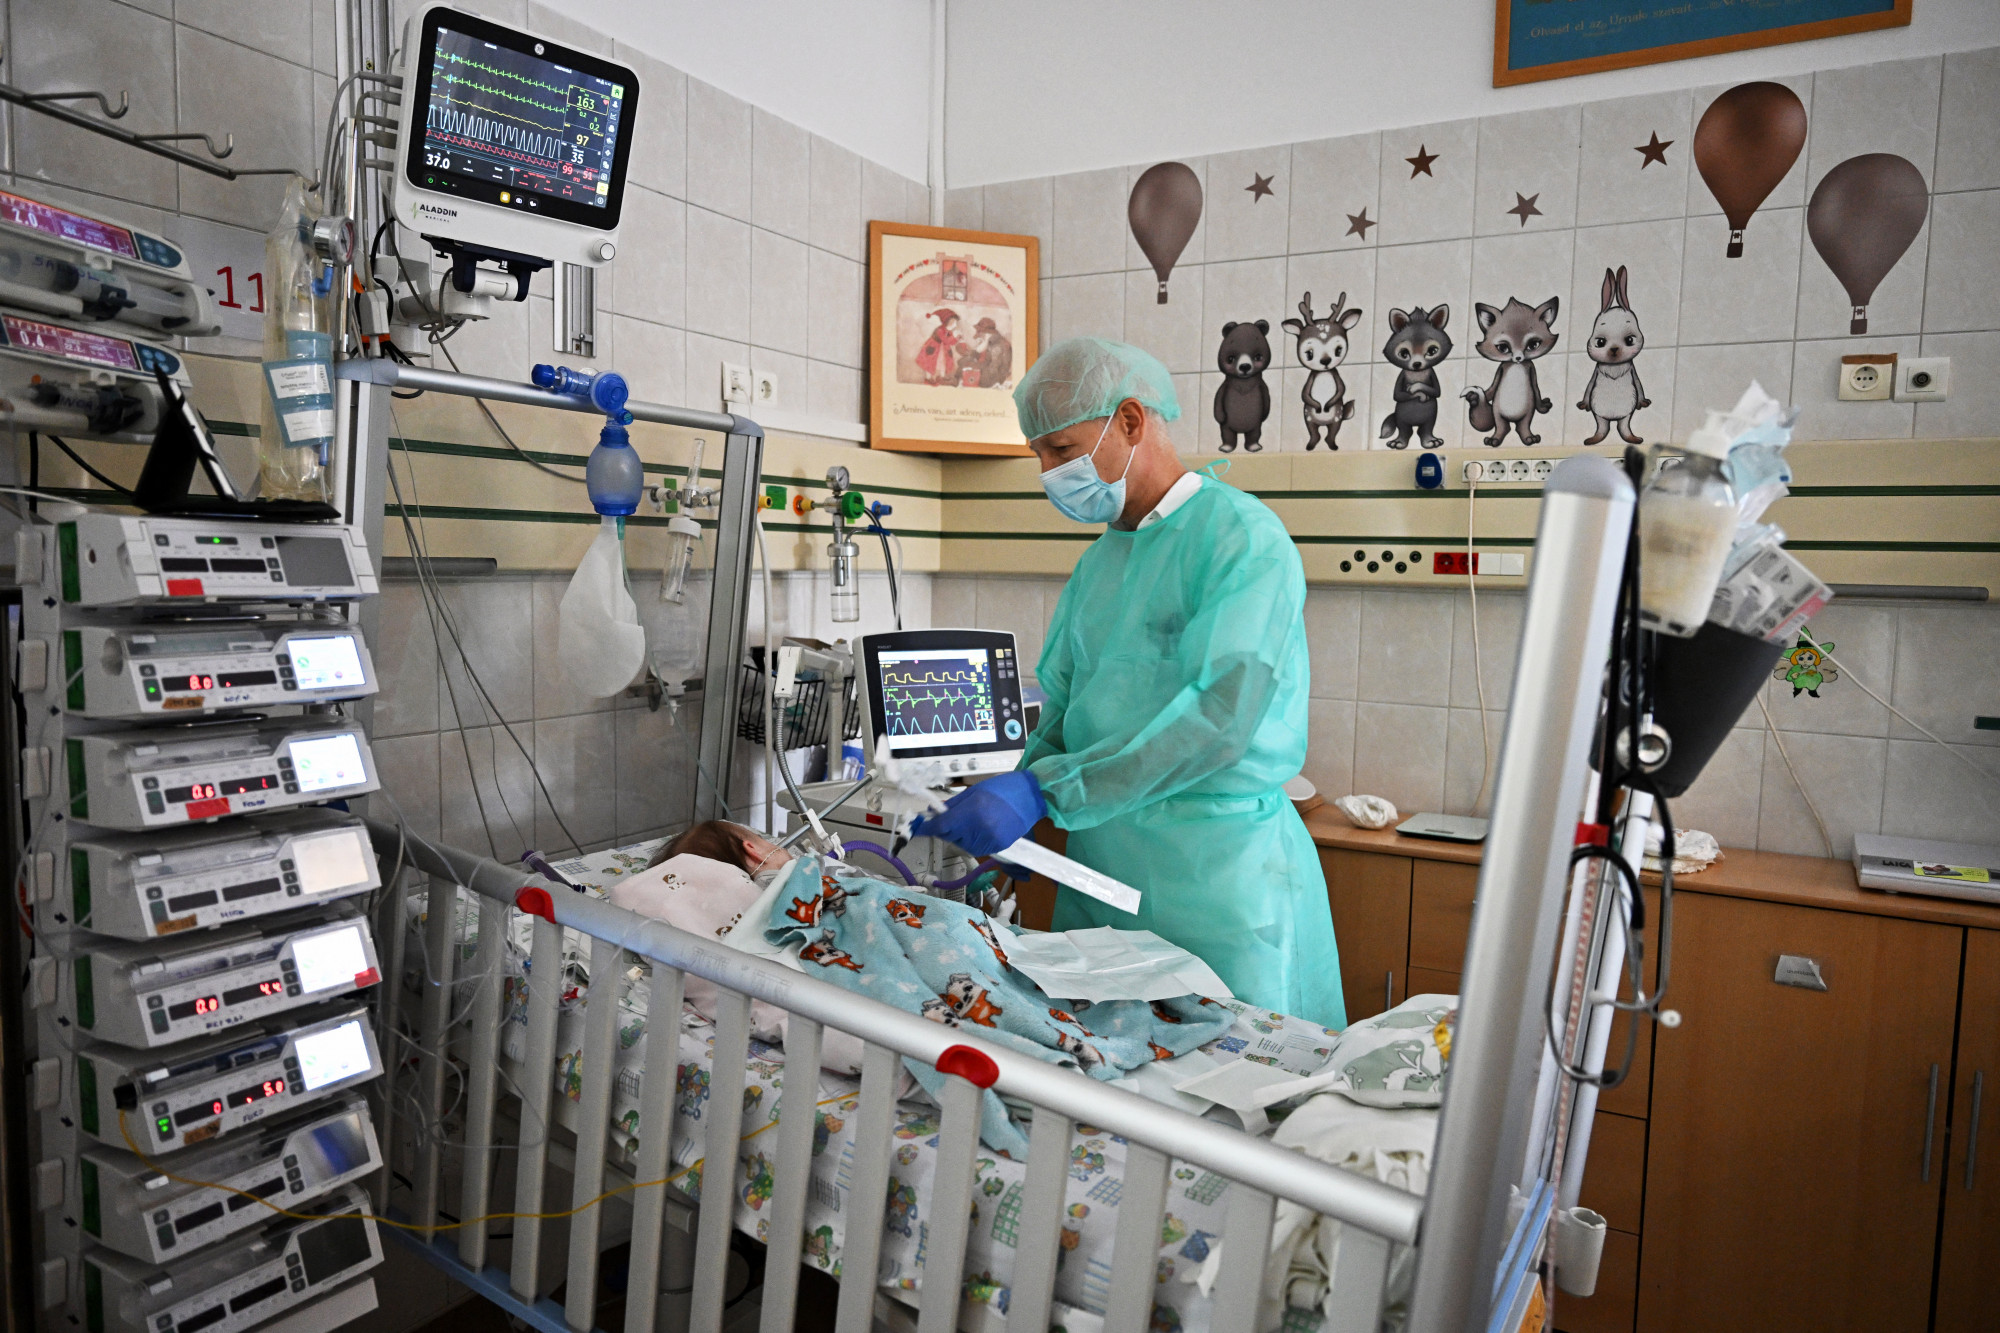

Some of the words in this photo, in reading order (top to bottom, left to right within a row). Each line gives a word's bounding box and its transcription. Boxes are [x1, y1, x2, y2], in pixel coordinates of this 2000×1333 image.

[576, 95, 595, 110] 163
[576, 134, 590, 147] 97
[425, 153, 450, 169] 37.0
[570, 151, 584, 165] 35
[562, 165, 573, 175] 99
[12, 207, 39, 228] 2.0
[419, 203, 458, 218] ALADDIN
[19, 330, 45, 348] 0.4
[1882, 859, 1912, 869] LAICA
